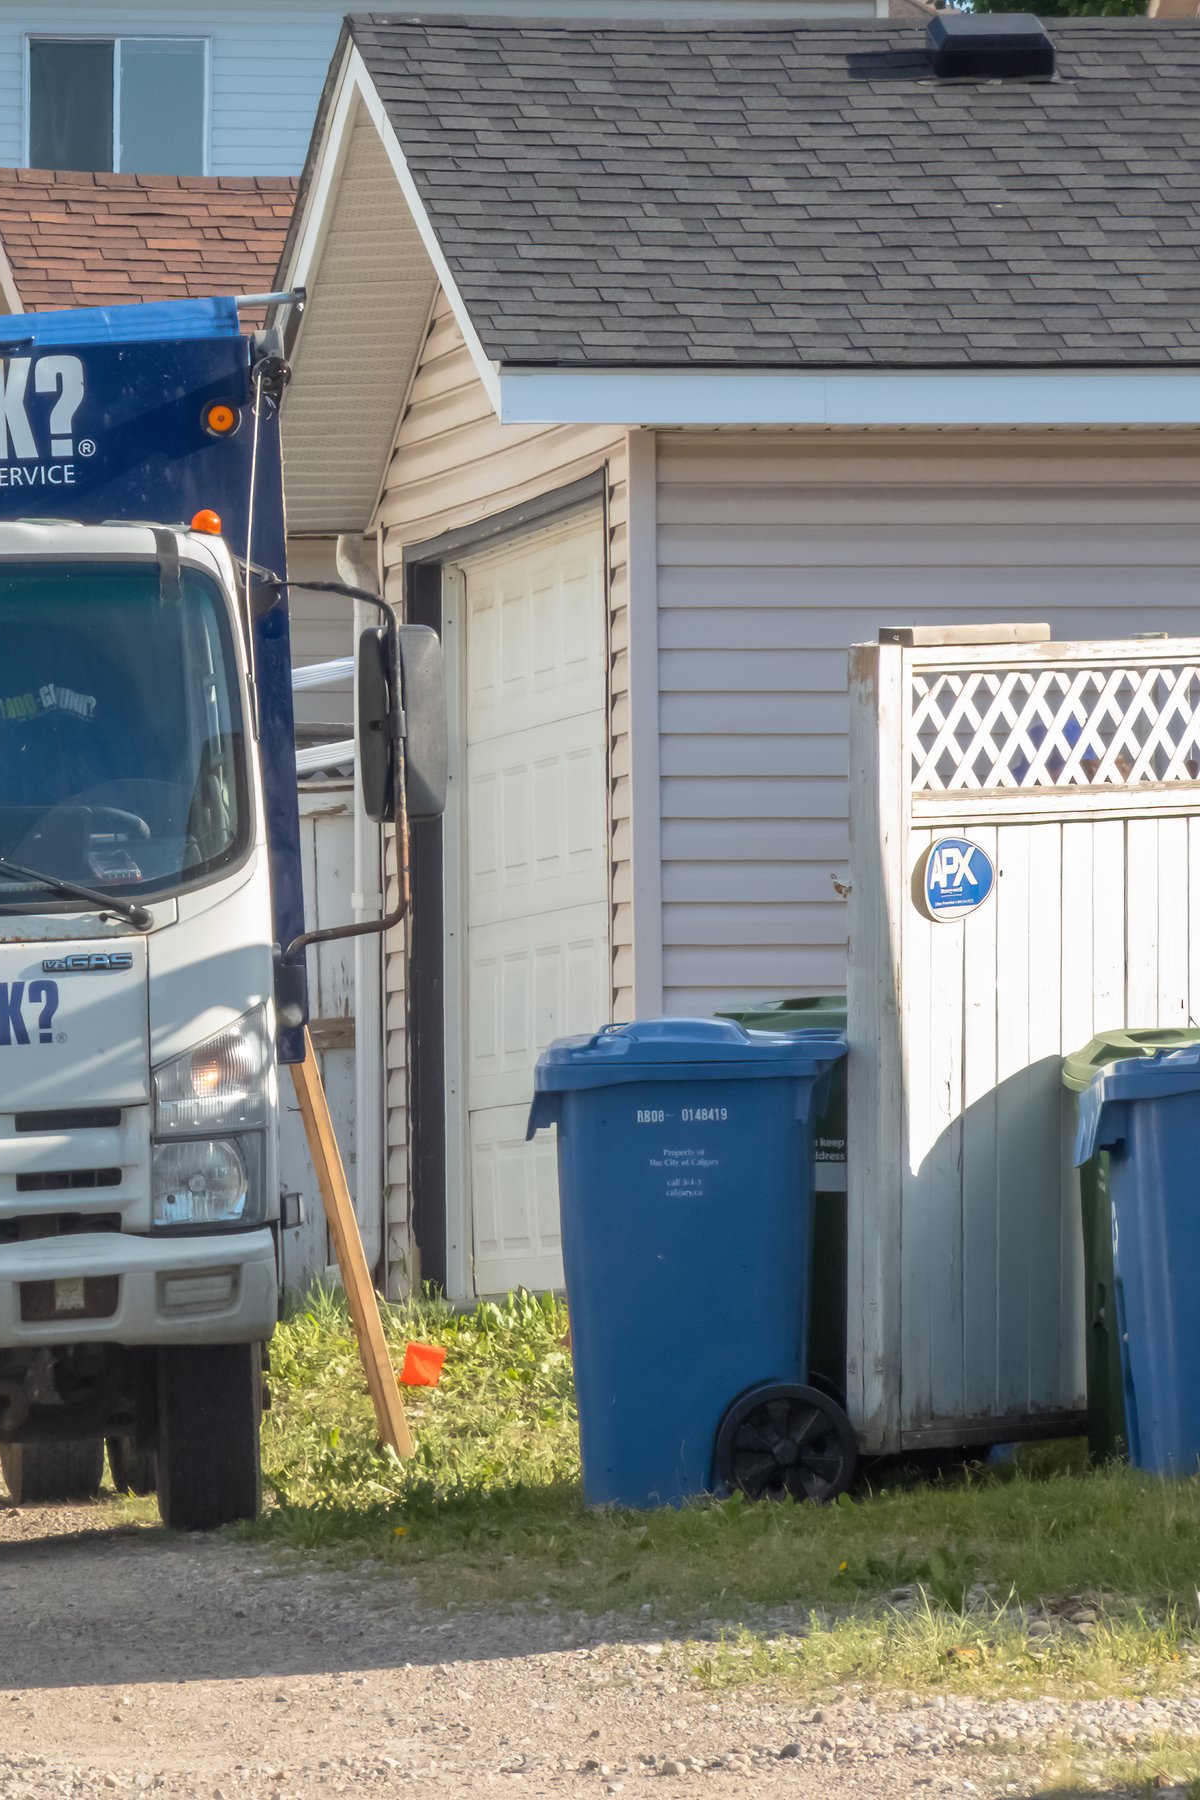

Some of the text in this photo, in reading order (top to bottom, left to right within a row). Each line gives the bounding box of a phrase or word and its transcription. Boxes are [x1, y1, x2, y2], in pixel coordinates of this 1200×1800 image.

[929, 846, 979, 890] APX
[66, 952, 133, 970] GAS
[681, 1108, 728, 1121] 0148419
[820, 1138, 845, 1149] keep
[664, 1159, 679, 1168] City
[691, 1159, 720, 1168] Calgary
